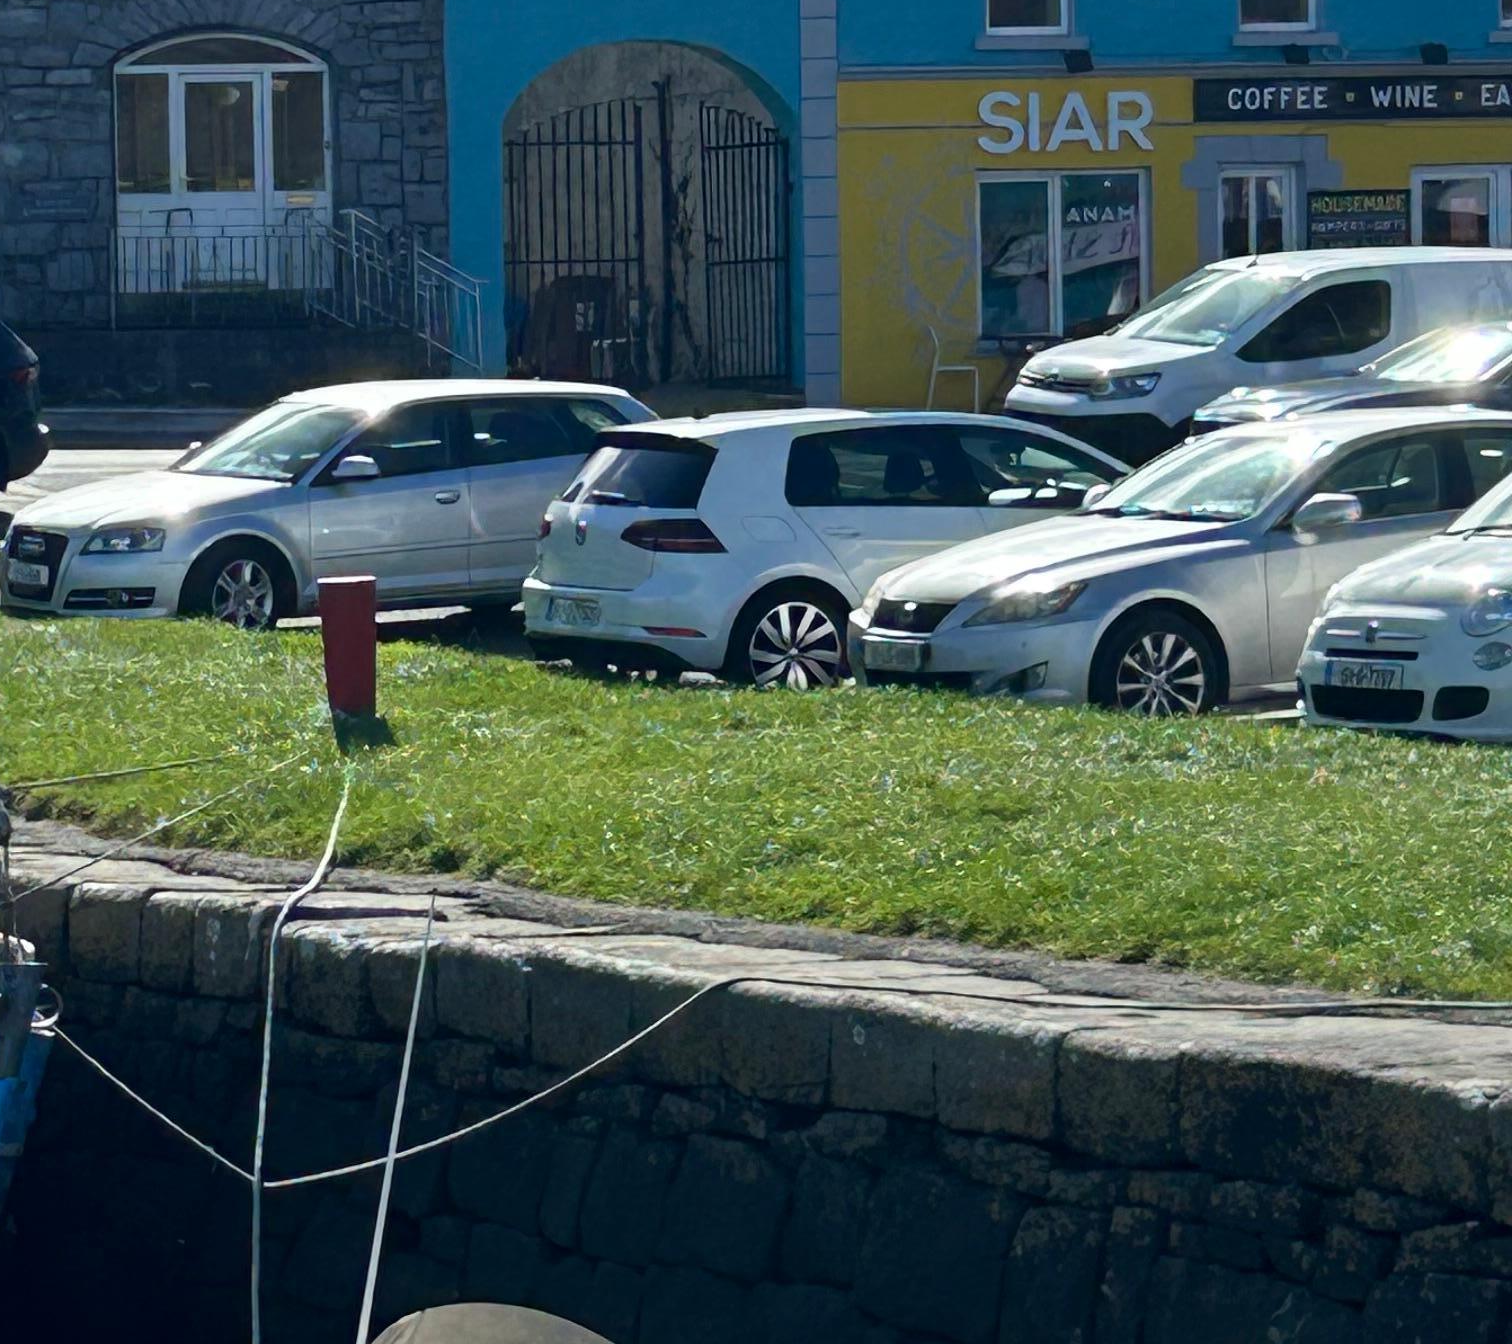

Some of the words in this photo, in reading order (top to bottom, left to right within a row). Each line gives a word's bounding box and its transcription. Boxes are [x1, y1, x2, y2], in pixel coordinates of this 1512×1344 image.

[1227, 86, 1328, 111] COFFEE
[1370, 84, 1438, 108] WINE
[977, 90, 1155, 154] SIAR
